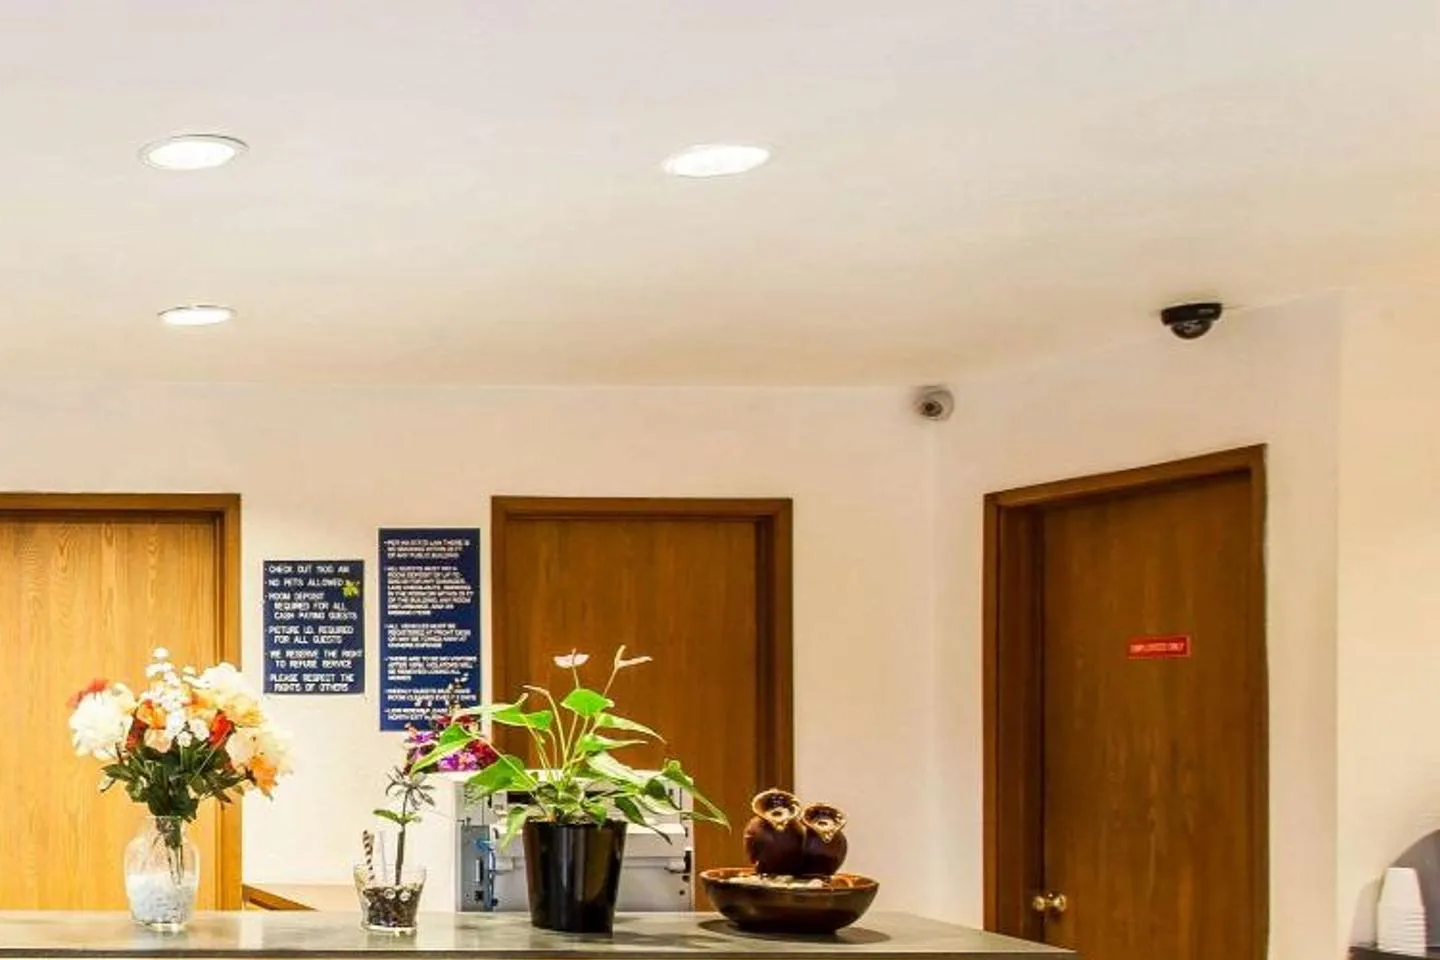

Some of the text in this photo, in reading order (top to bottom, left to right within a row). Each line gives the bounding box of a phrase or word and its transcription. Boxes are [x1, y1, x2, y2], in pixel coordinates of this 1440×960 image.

[268, 565, 293, 574] CHECK
[297, 565, 312, 574] OUT
[337, 565, 350, 574] AM
[268, 578, 344, 587] NO PETS ALLOWED
[268, 592, 325, 601] ROOM DEPOSIT
[274, 602, 348, 611] REQUIRED FOR ALL
[274, 612, 358, 621] CASH PAYING GUESTS
[268, 625, 300, 635] PICTURE
[318, 625, 355, 635] REQUIRED
[274, 635, 343, 644] FOR ALL GUESTS
[270, 650, 363, 659] WE RESERVE THE RIGHT
[275, 660, 353, 669] TO REFUSE SERVICE
[269, 673, 355, 683] PLEASE RESPECT THE
[273, 683, 349, 693] RIGHTS OF OTHERS
